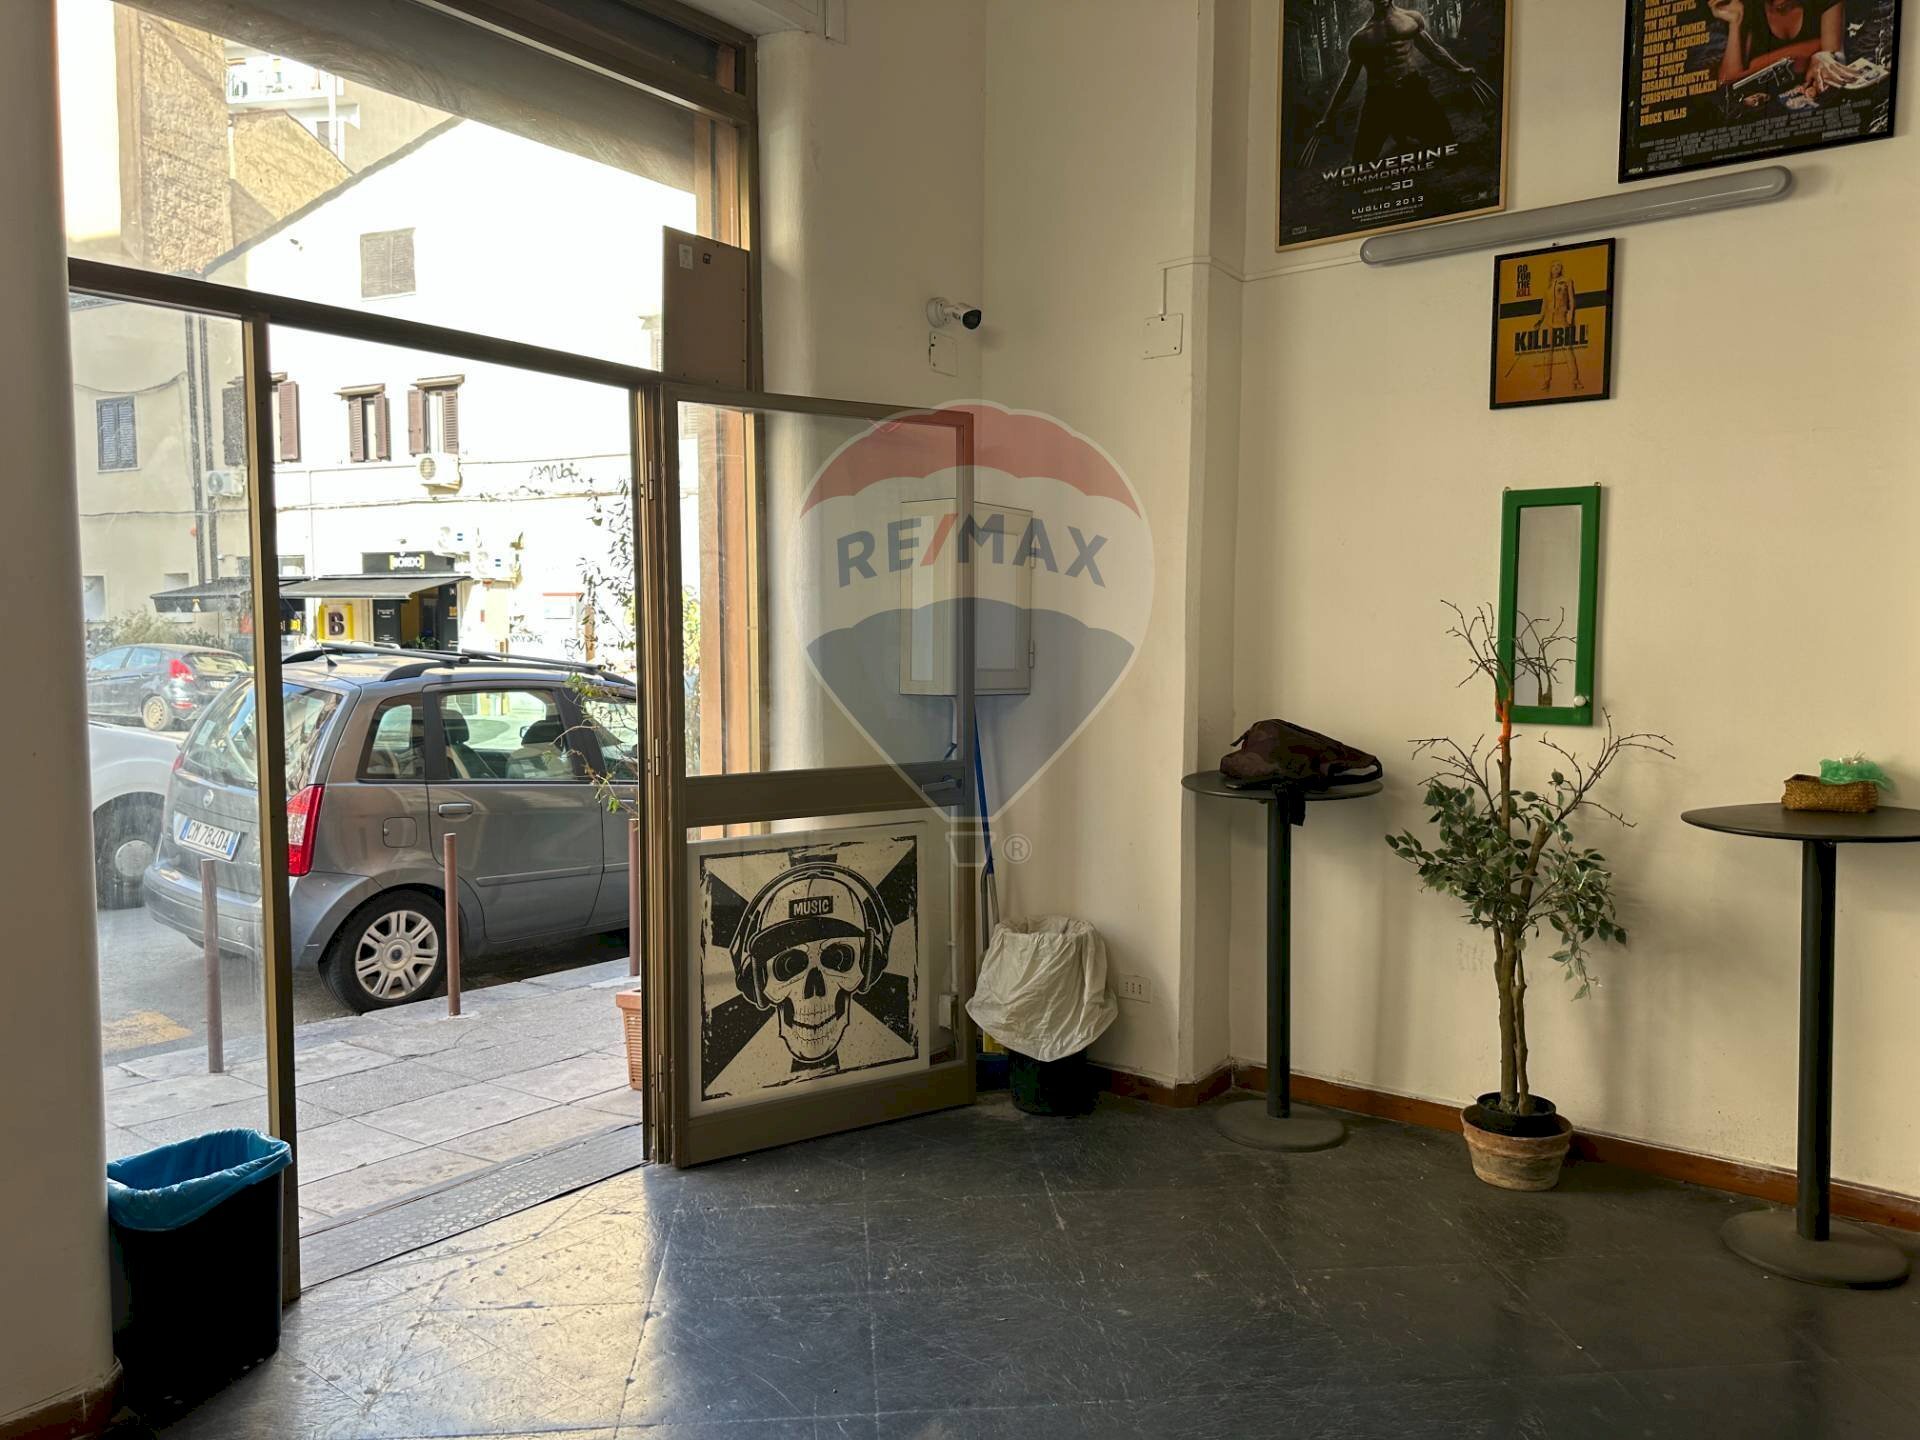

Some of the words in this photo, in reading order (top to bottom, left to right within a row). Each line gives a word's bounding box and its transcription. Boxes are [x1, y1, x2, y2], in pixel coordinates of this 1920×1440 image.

[1644, 30, 1671, 45] AMANDA
[1674, 21, 1706, 38] PLUMMER
[1645, 20, 1657, 32] TIM
[1659, 16, 1677, 29] ROTH
[1644, 43, 1665, 56] MARIA
[1641, 87, 1687, 106] CHRISTOPHER
[1690, 81, 1717, 96] WALKEN
[1641, 112, 1662, 127] BRUCE
[1664, 107, 1687, 121] WILLIS
[1320, 143, 1459, 181] WOLVERINE
[1342, 161, 1436, 187] L'IMMORTALE
[1391, 179, 1414, 191] 3D
[1351, 202, 1391, 215] LUGLIO
[1395, 195, 1424, 206] 2013
[793, 898, 830, 916] MUSIC
